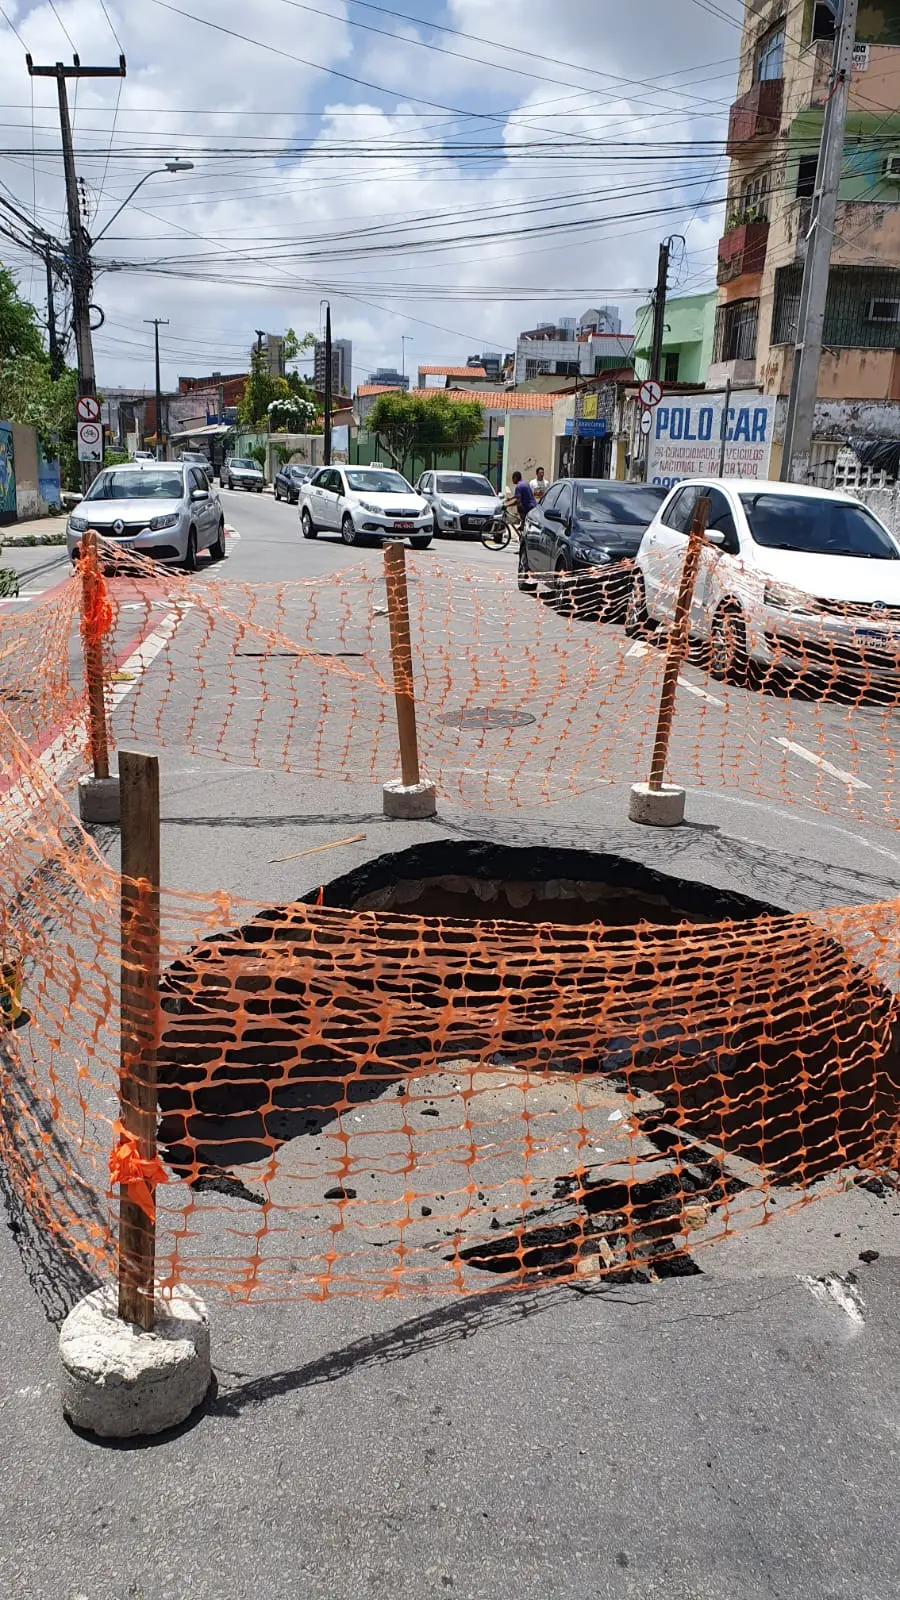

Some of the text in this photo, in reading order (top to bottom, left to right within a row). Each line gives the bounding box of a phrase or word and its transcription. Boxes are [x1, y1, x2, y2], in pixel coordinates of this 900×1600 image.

[655, 407, 768, 442] POLO CAR
[659, 460, 758, 475] NACIONAL E IMORTADO
